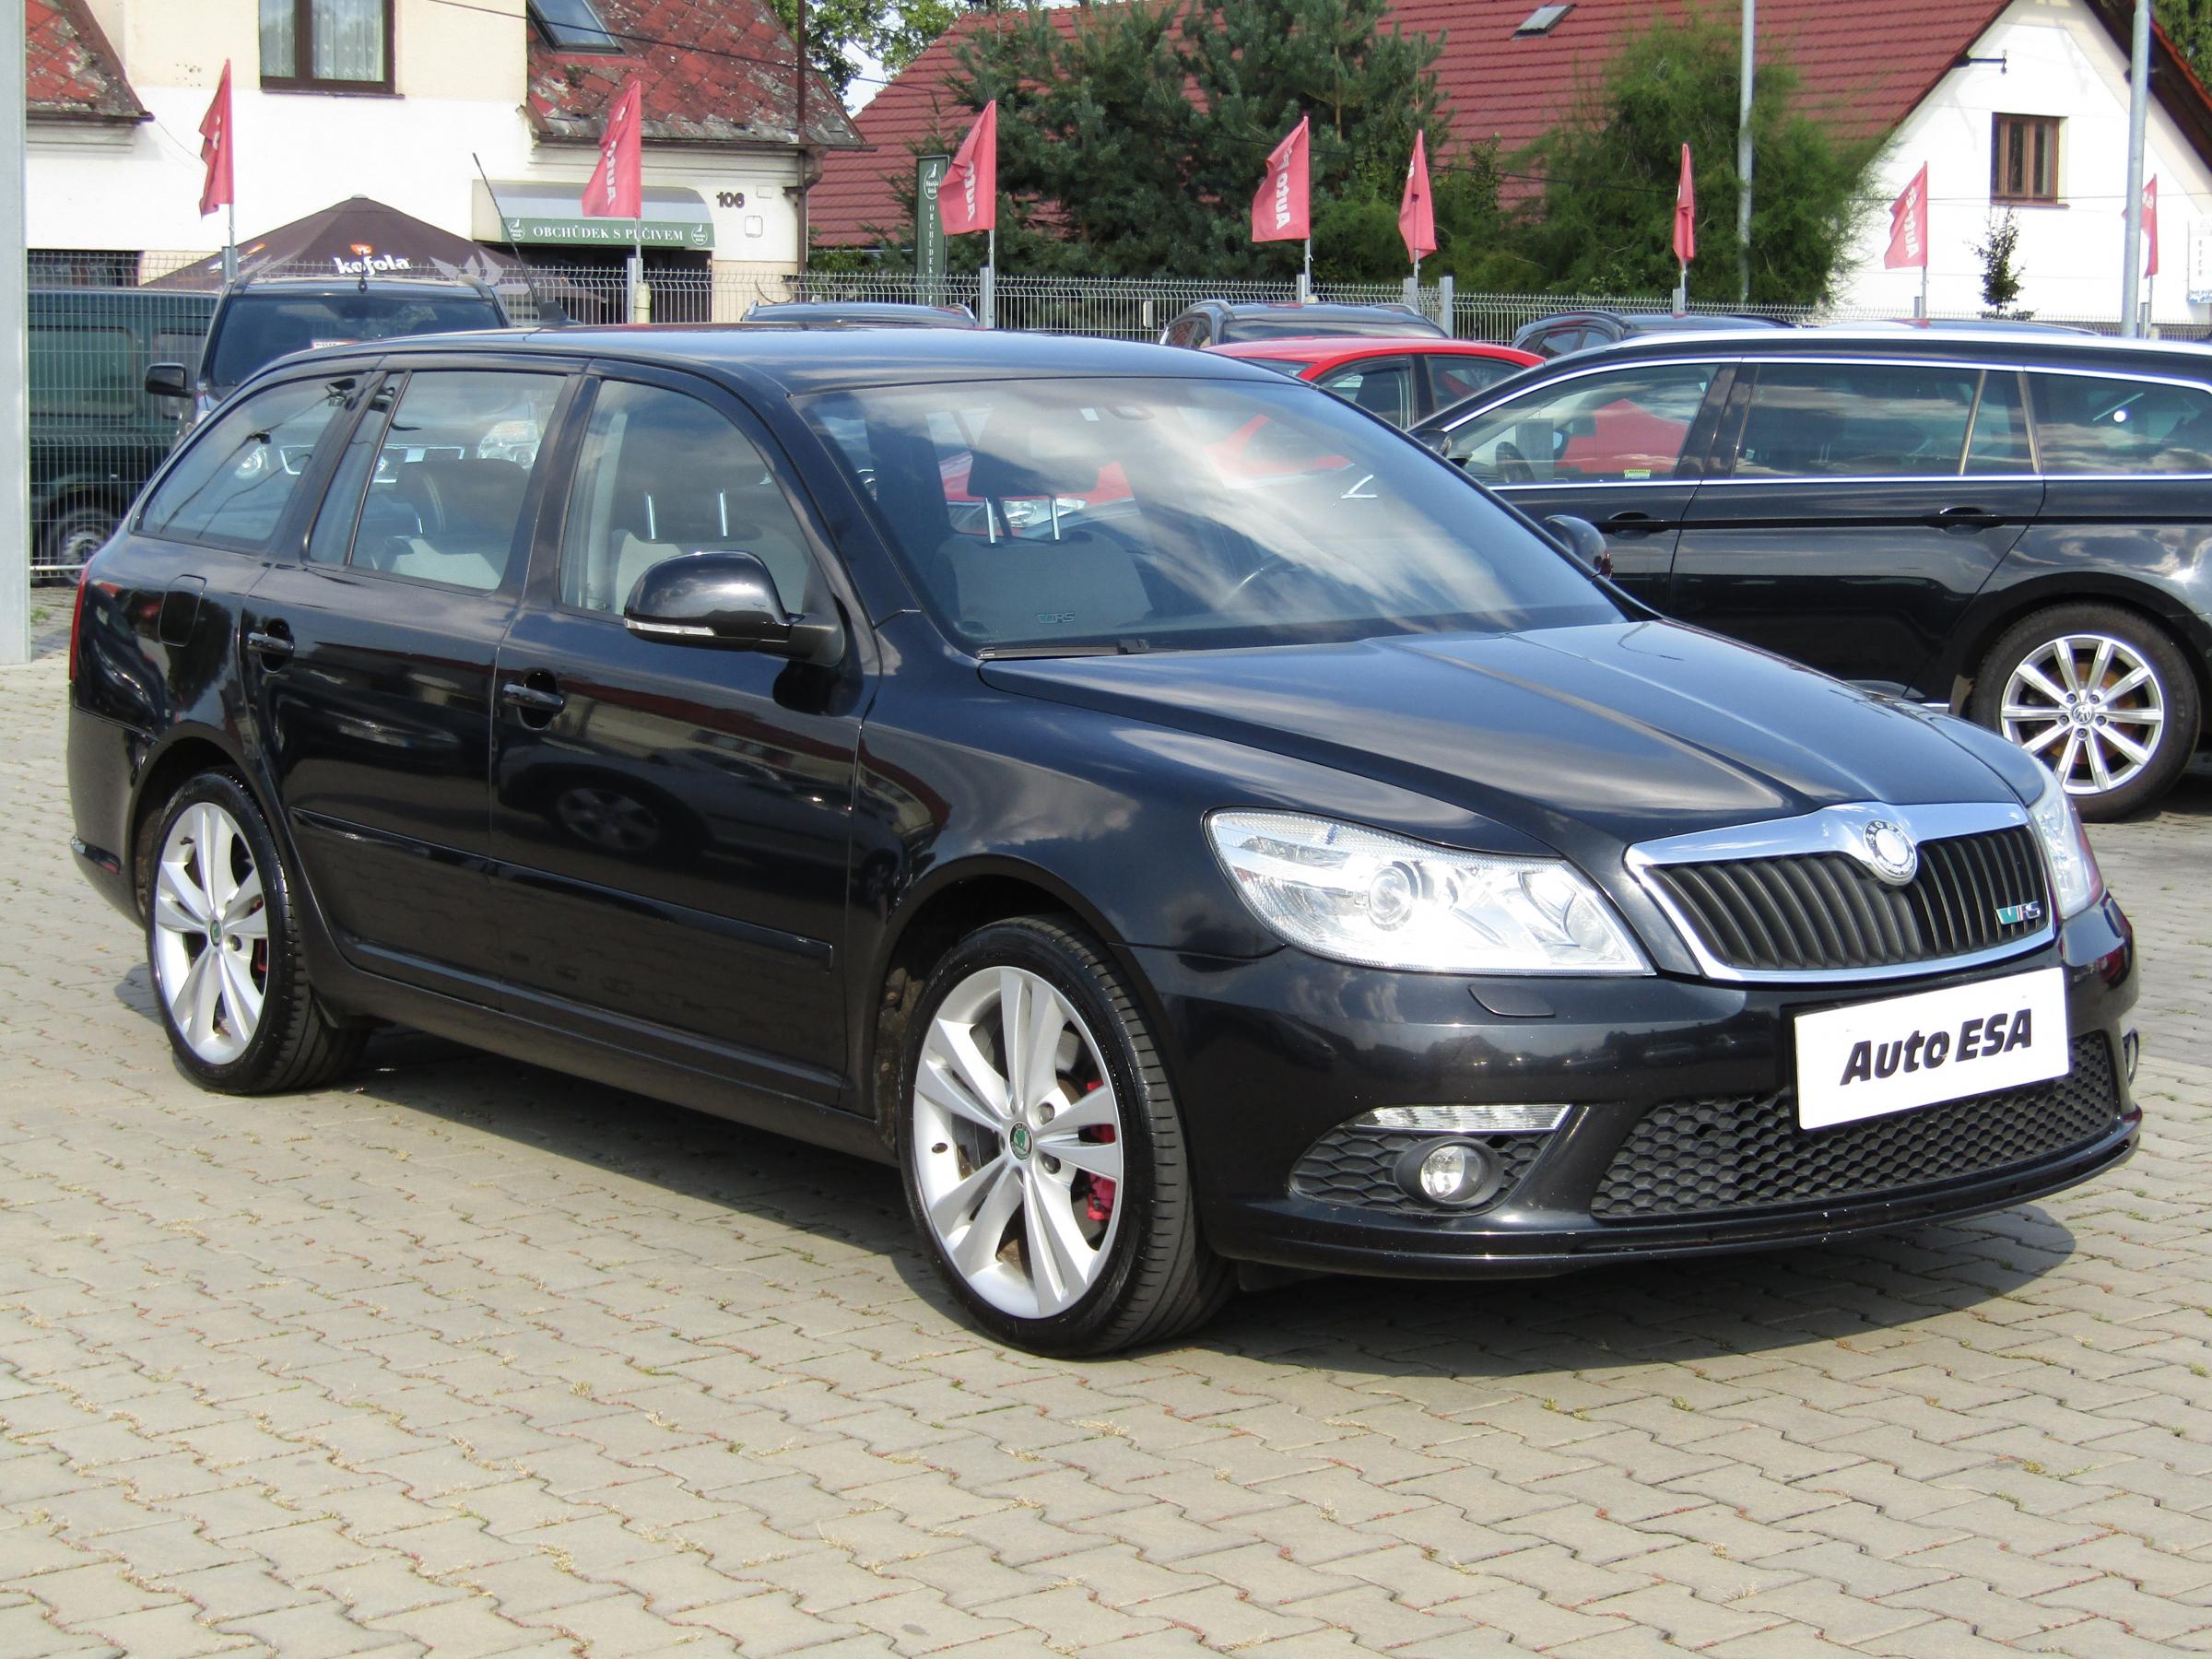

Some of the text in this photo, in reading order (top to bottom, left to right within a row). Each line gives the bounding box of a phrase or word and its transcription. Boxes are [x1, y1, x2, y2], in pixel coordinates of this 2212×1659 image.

[716, 192, 745, 207] 106
[533, 225, 609, 239] OBCHŮDEK
[613, 229, 621, 240] S
[334, 254, 411, 276] kofola
[1840, 1008, 2031, 1086] Auto ESA
